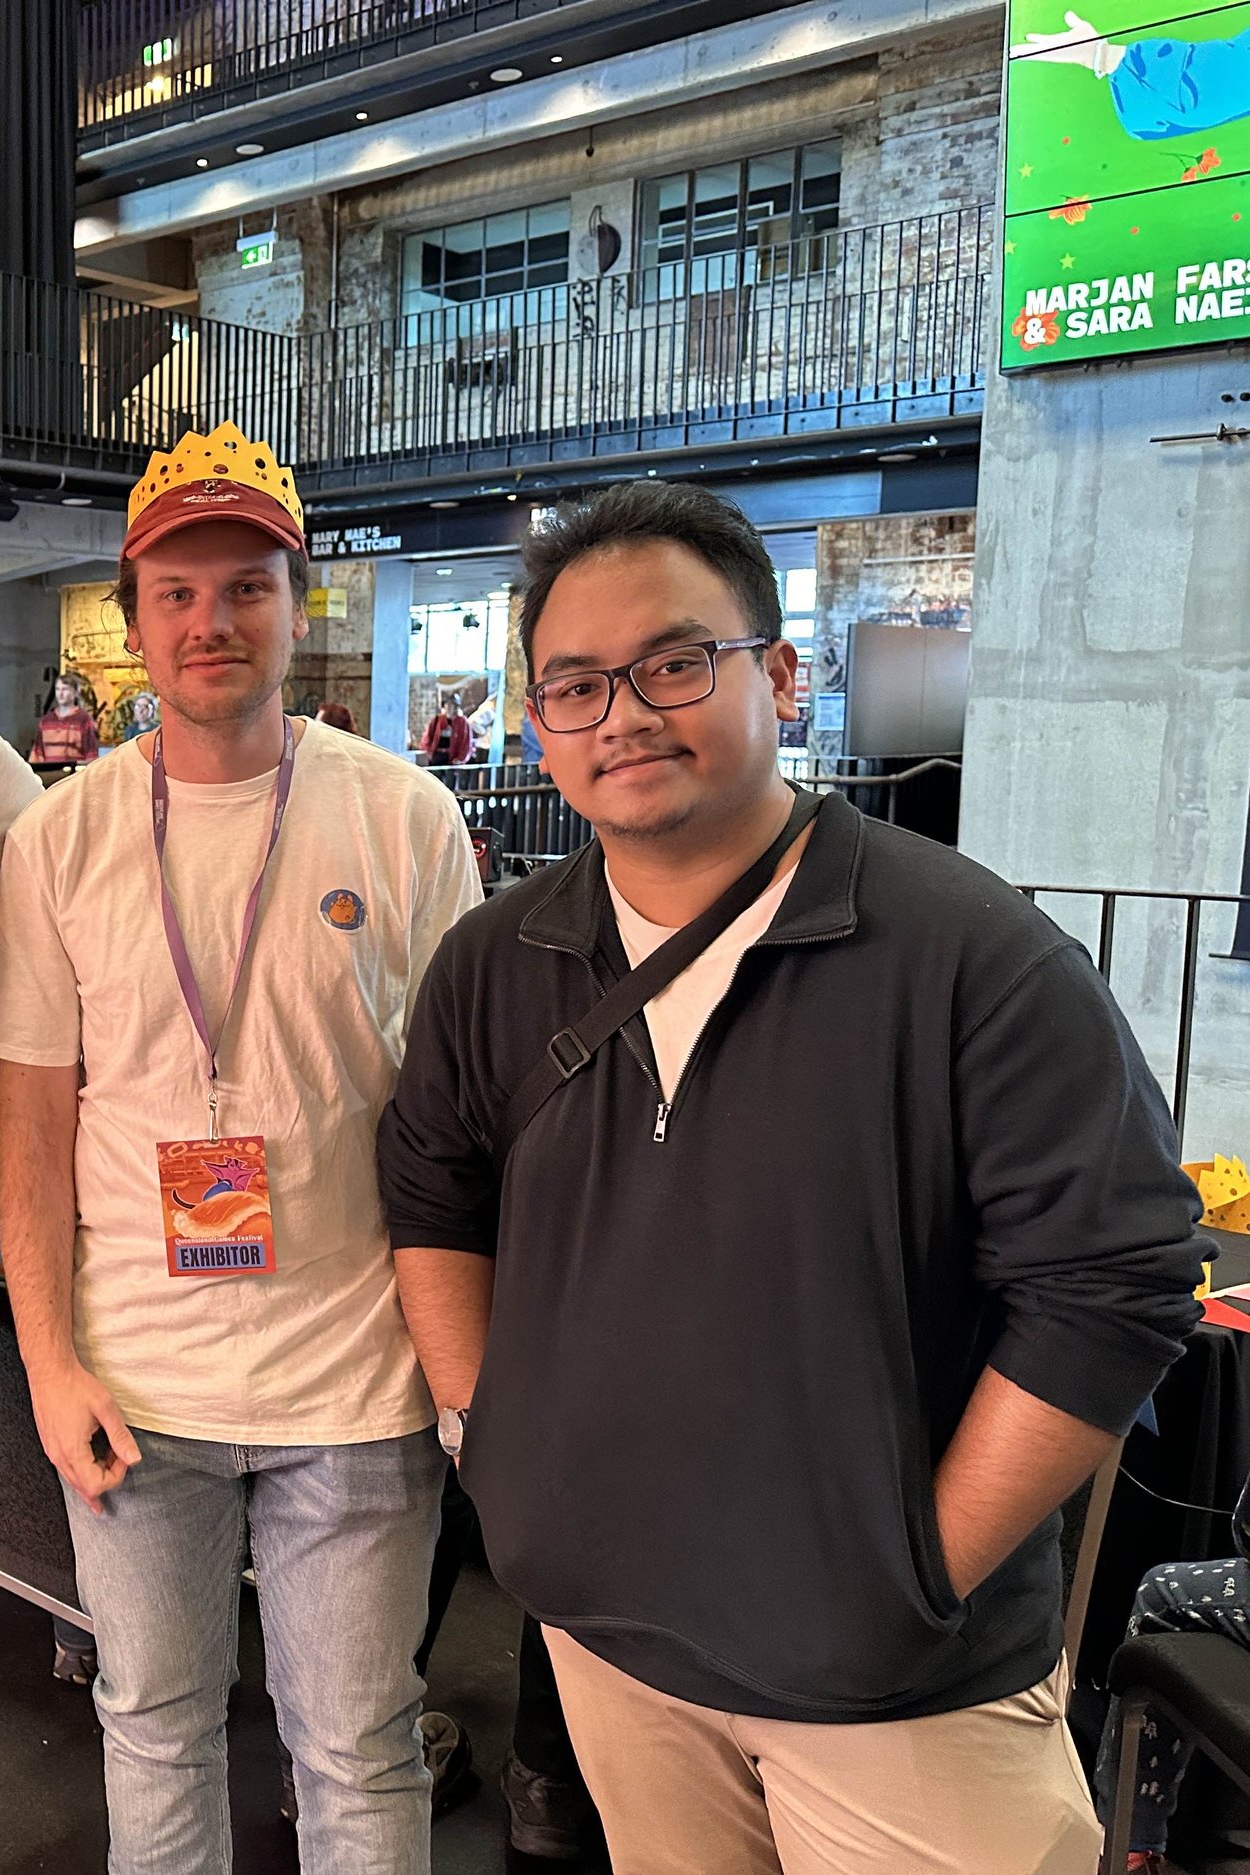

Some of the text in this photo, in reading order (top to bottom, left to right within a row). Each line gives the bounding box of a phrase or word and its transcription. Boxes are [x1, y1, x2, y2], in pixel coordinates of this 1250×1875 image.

[1025, 257, 1250, 317] MARJAN FAR
[1023, 318, 1046, 344] &
[1065, 302, 1154, 339] SARA
[311, 543, 333, 556] BAR
[351, 535, 402, 553] KITCHEN
[312, 526, 381, 544] MARY MAE'S
[180, 1246, 261, 1268] EXHIBITOR
